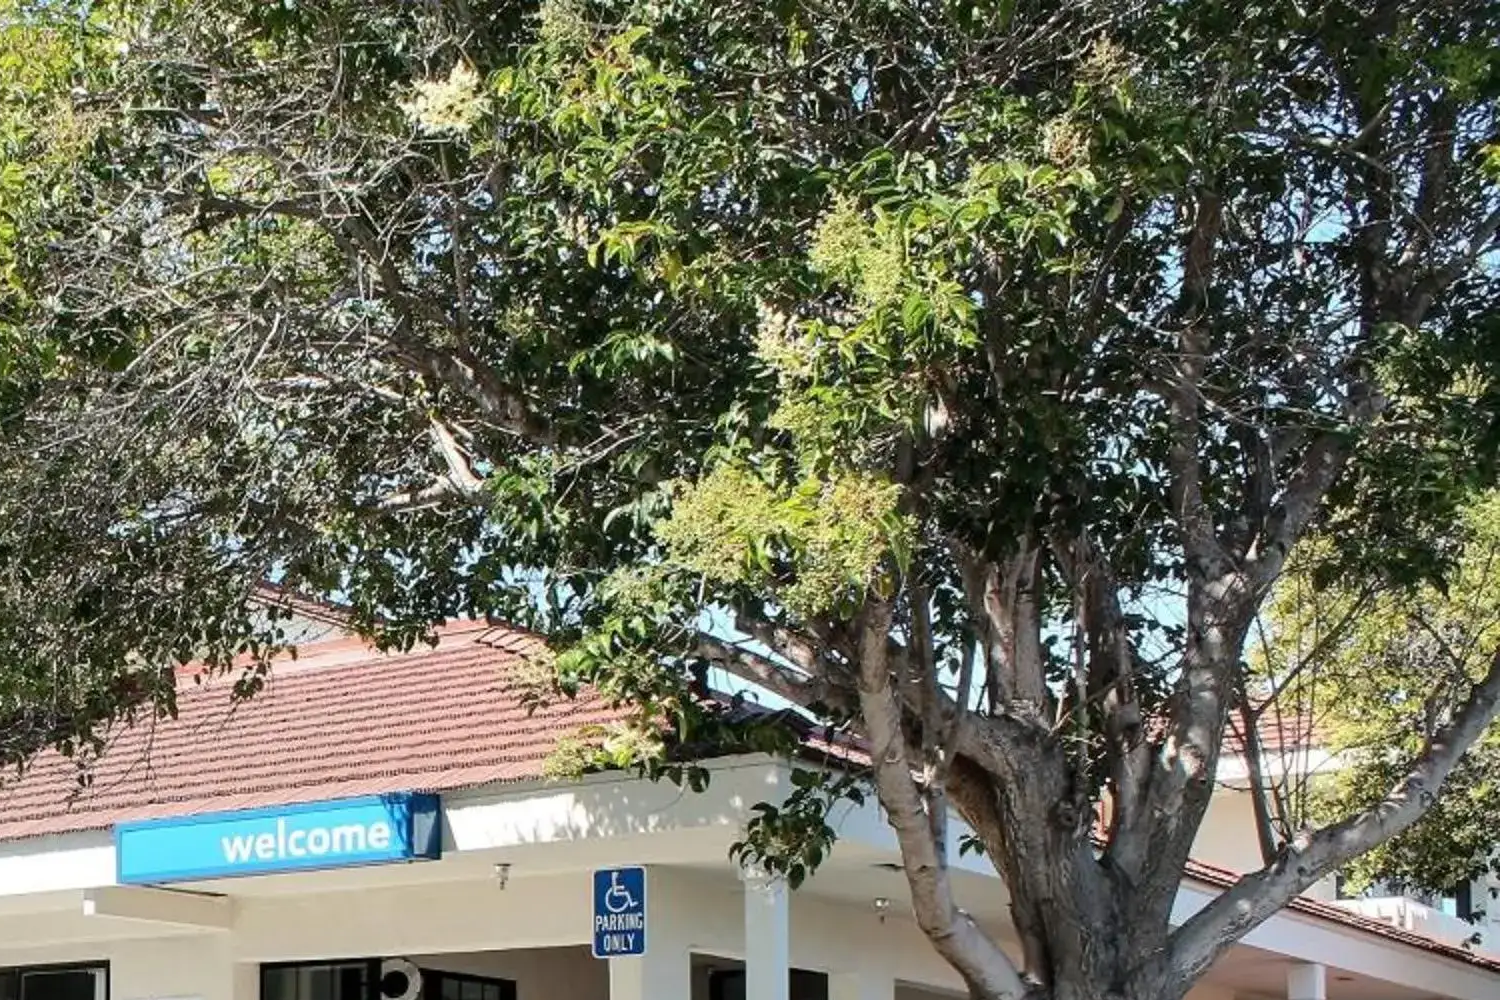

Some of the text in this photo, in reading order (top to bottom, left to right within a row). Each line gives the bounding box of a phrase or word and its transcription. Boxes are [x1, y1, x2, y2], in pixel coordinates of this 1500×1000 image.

[221, 815, 391, 864] welcome
[595, 912, 643, 932] PARKING
[603, 932, 635, 952] ONLY
